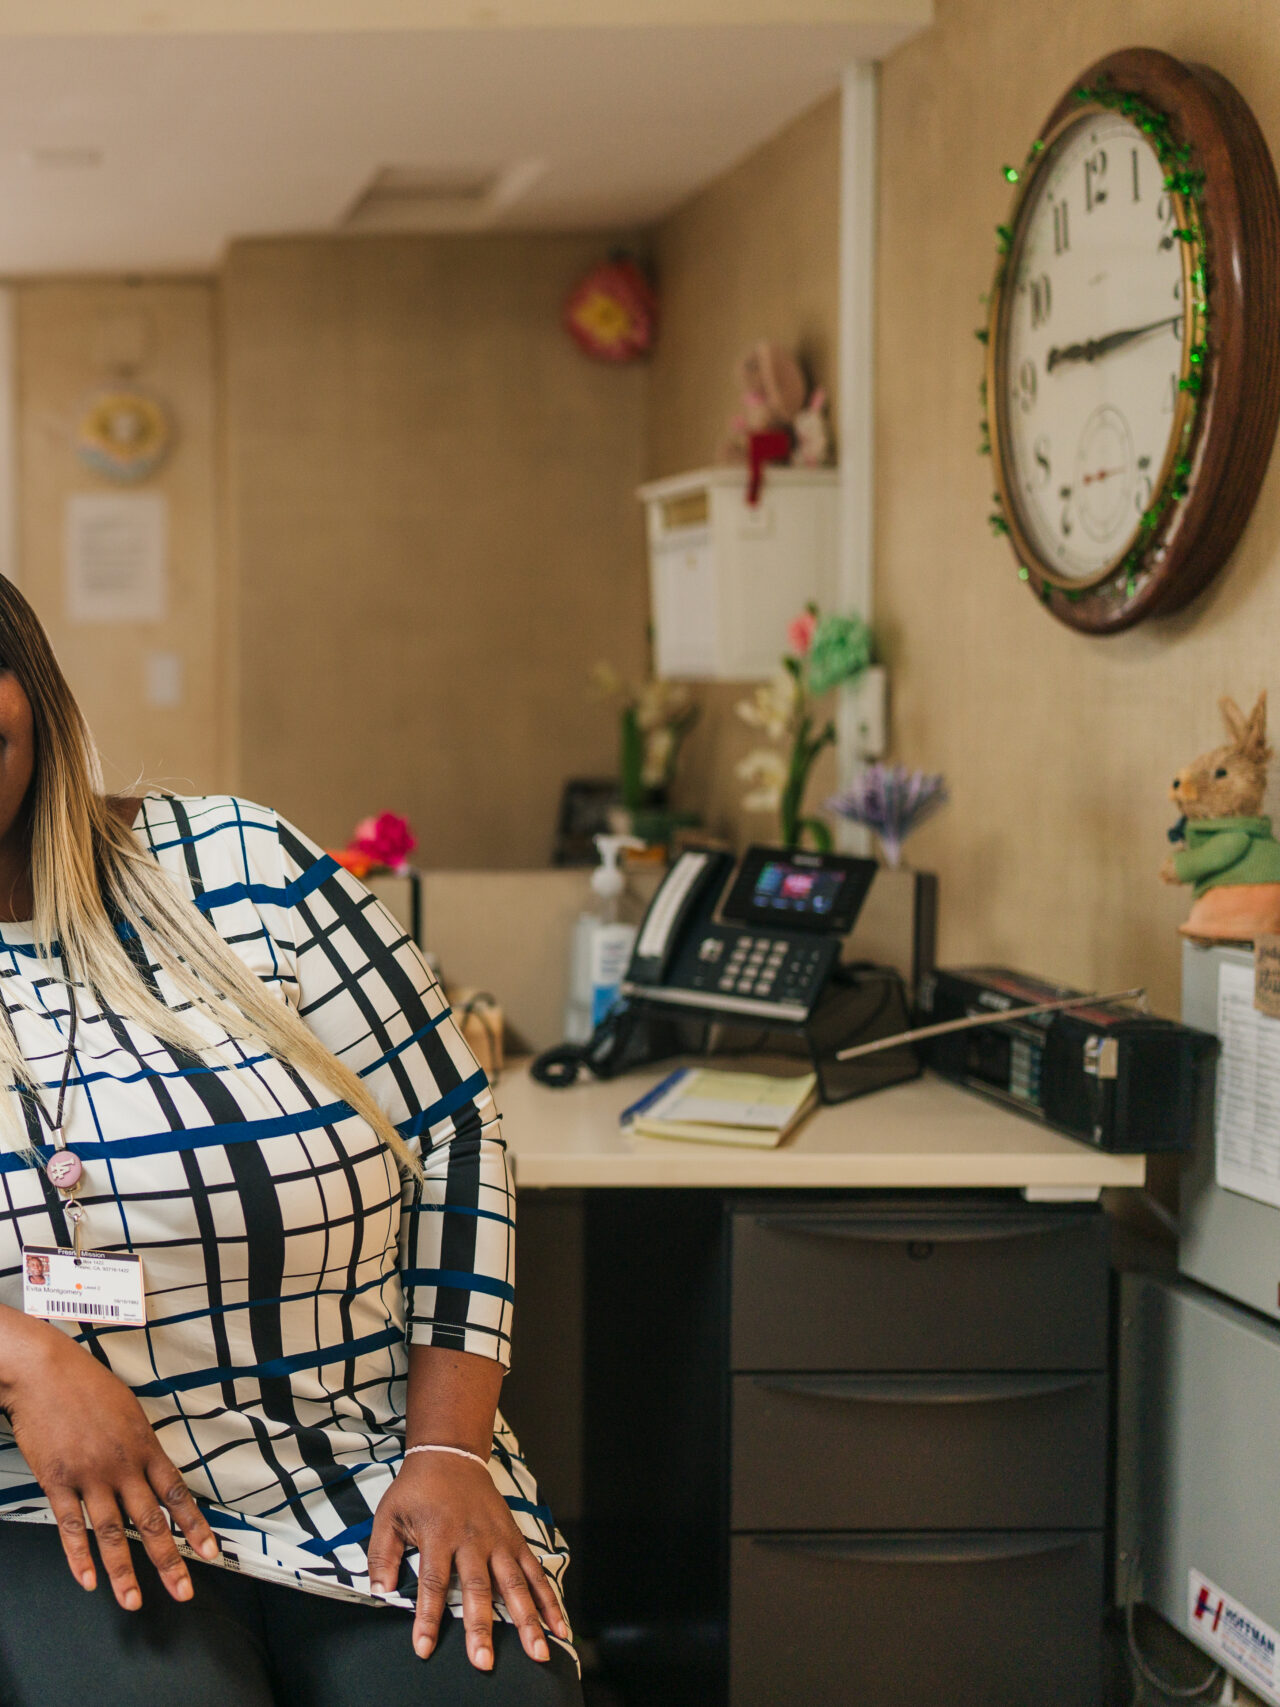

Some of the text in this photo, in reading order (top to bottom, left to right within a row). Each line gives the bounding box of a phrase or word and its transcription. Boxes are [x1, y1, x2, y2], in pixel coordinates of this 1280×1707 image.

[1084, 150, 1107, 213] 12
[1131, 148, 1140, 203] 1
[1052, 198, 1071, 256] 11
[1029, 273, 1052, 331] 10
[81, 1250, 106, 1259] Mission
[44, 1287, 83, 1297] Montgomery
